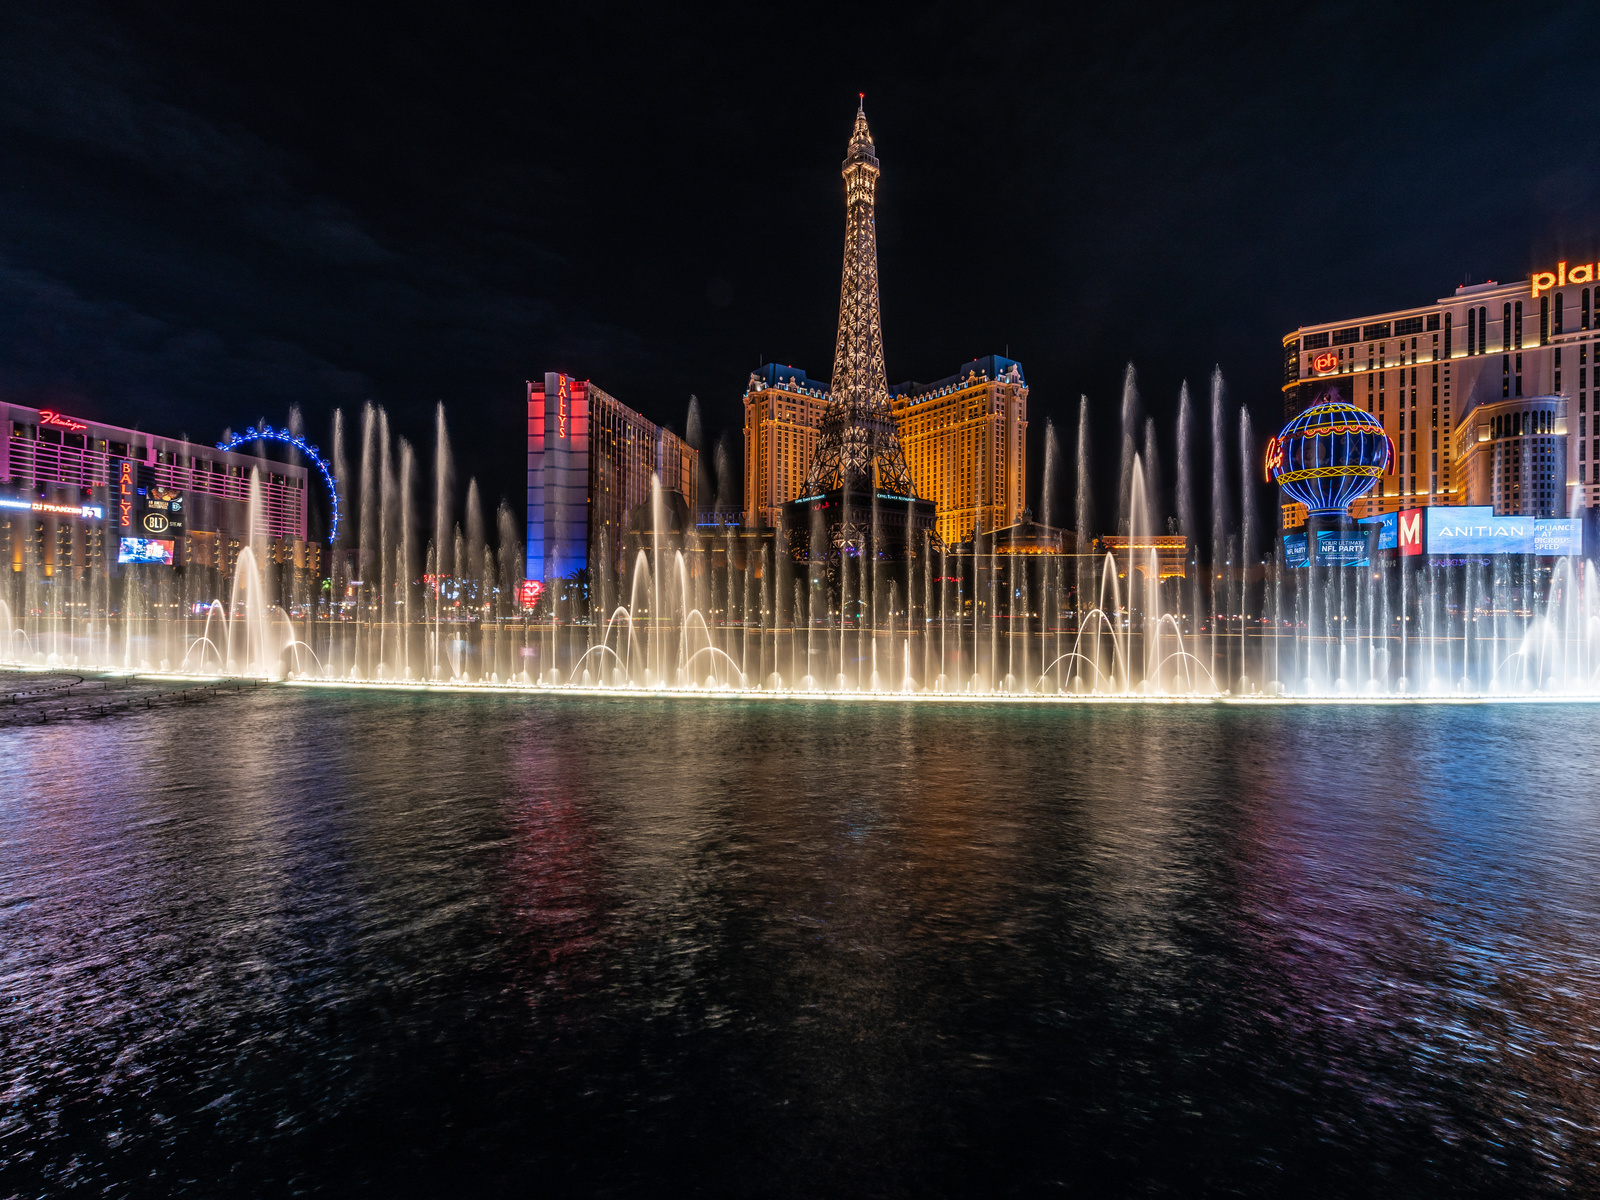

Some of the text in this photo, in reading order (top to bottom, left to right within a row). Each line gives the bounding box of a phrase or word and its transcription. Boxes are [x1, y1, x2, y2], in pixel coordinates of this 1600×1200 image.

[39, 410, 87, 431] Flamingo
[149, 517, 163, 529] BLT
[1400, 513, 1420, 546] M
[1438, 525, 1524, 537] ANITIAN
